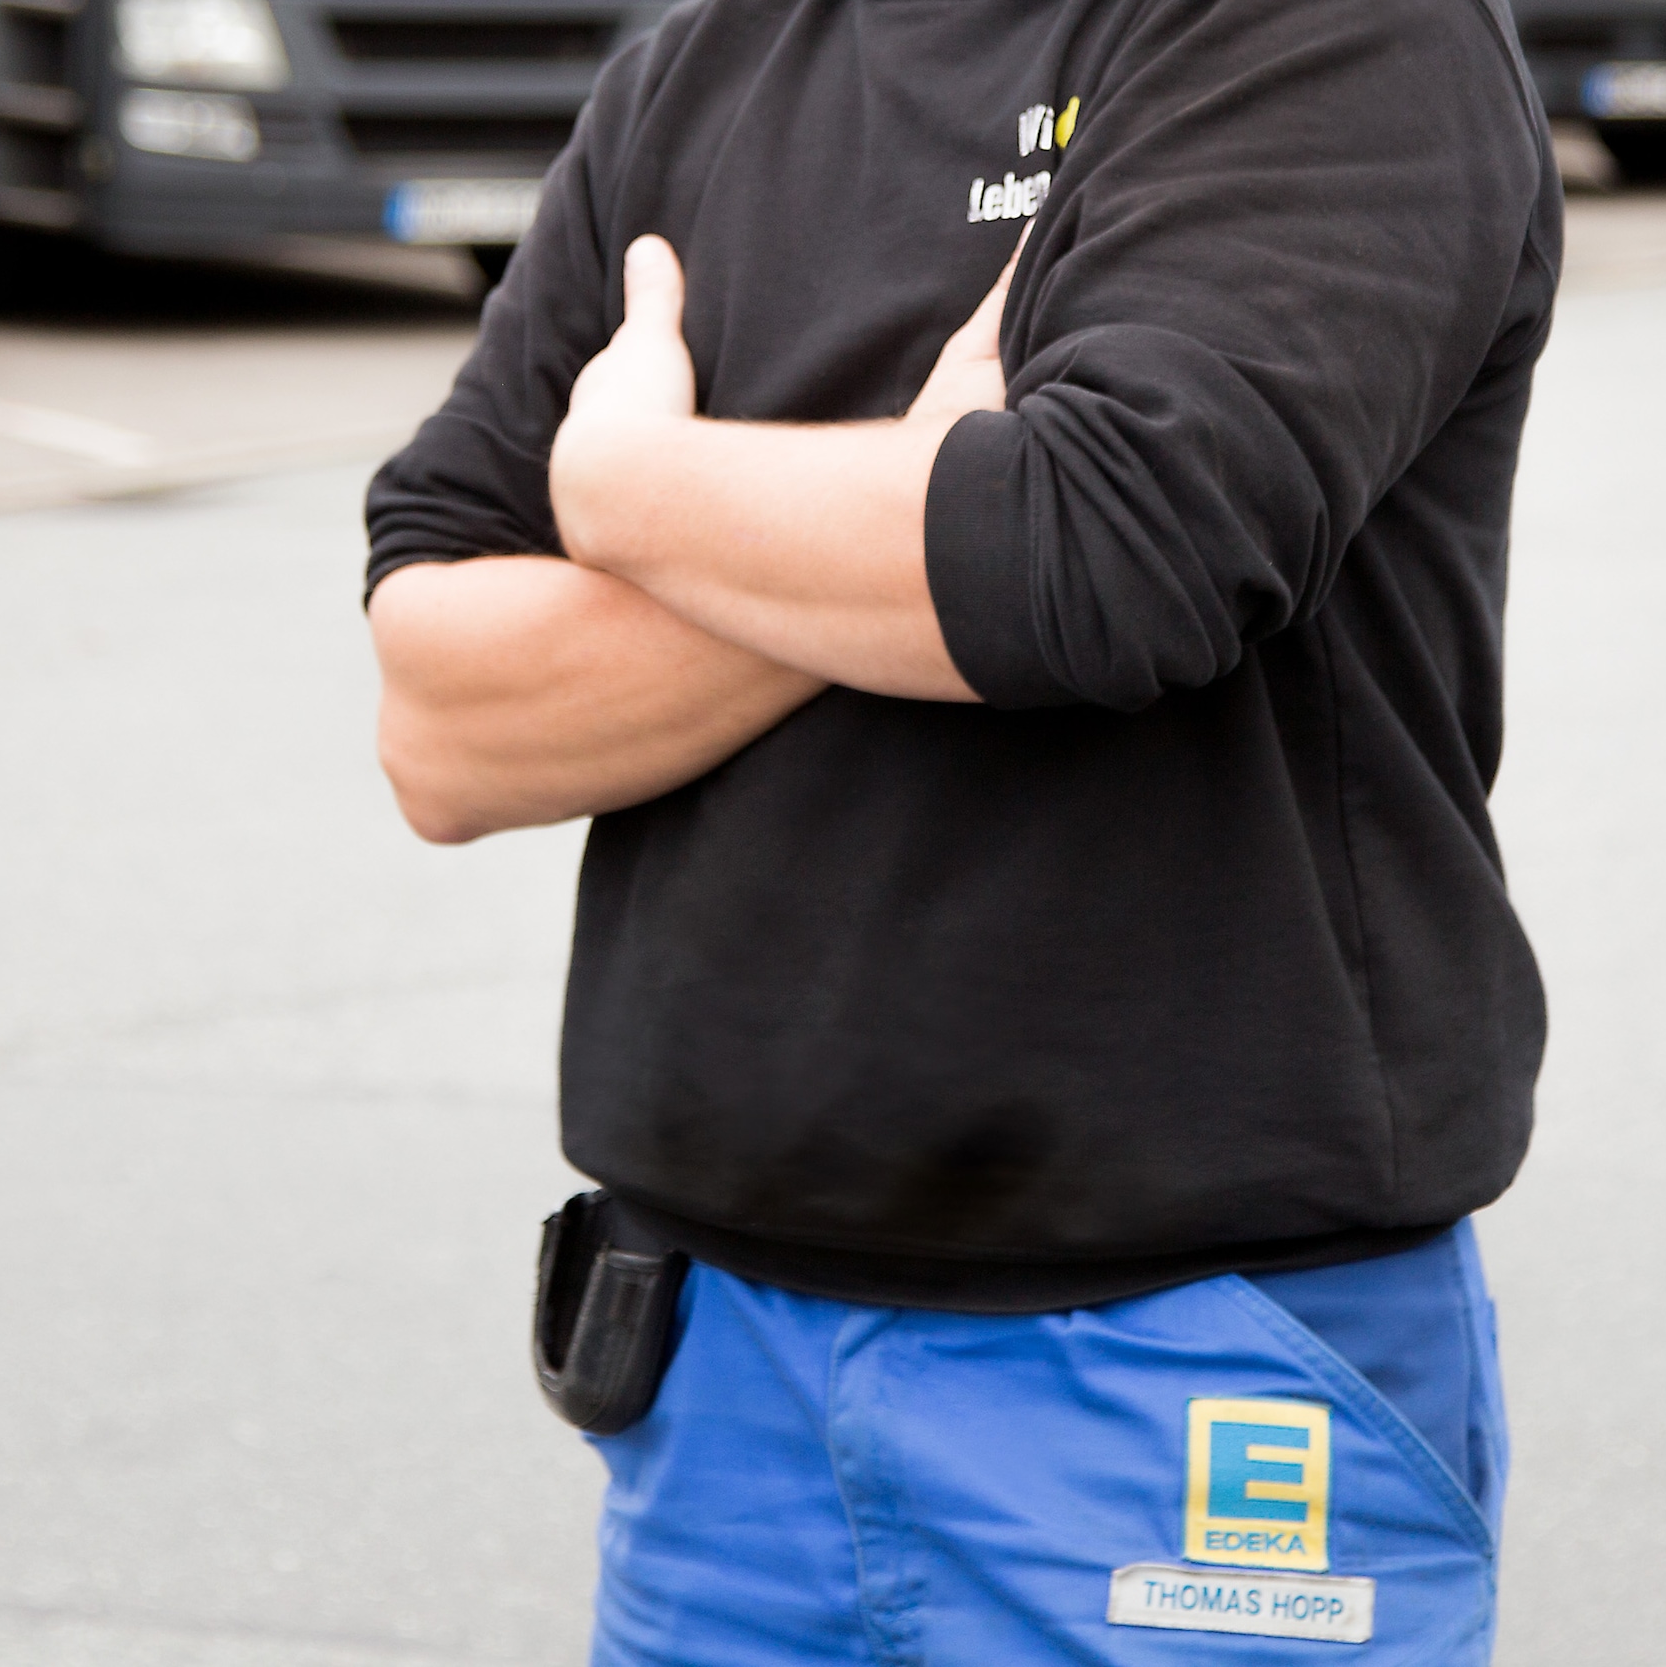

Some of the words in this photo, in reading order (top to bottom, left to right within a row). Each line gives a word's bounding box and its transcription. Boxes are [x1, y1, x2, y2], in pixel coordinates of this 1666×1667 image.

[1207, 1420, 1310, 1523] E
[1204, 1530, 1308, 1556] EDEKA
[1144, 1580, 1262, 1616] THOMAS
[1271, 1592, 1345, 1624] HOPP
